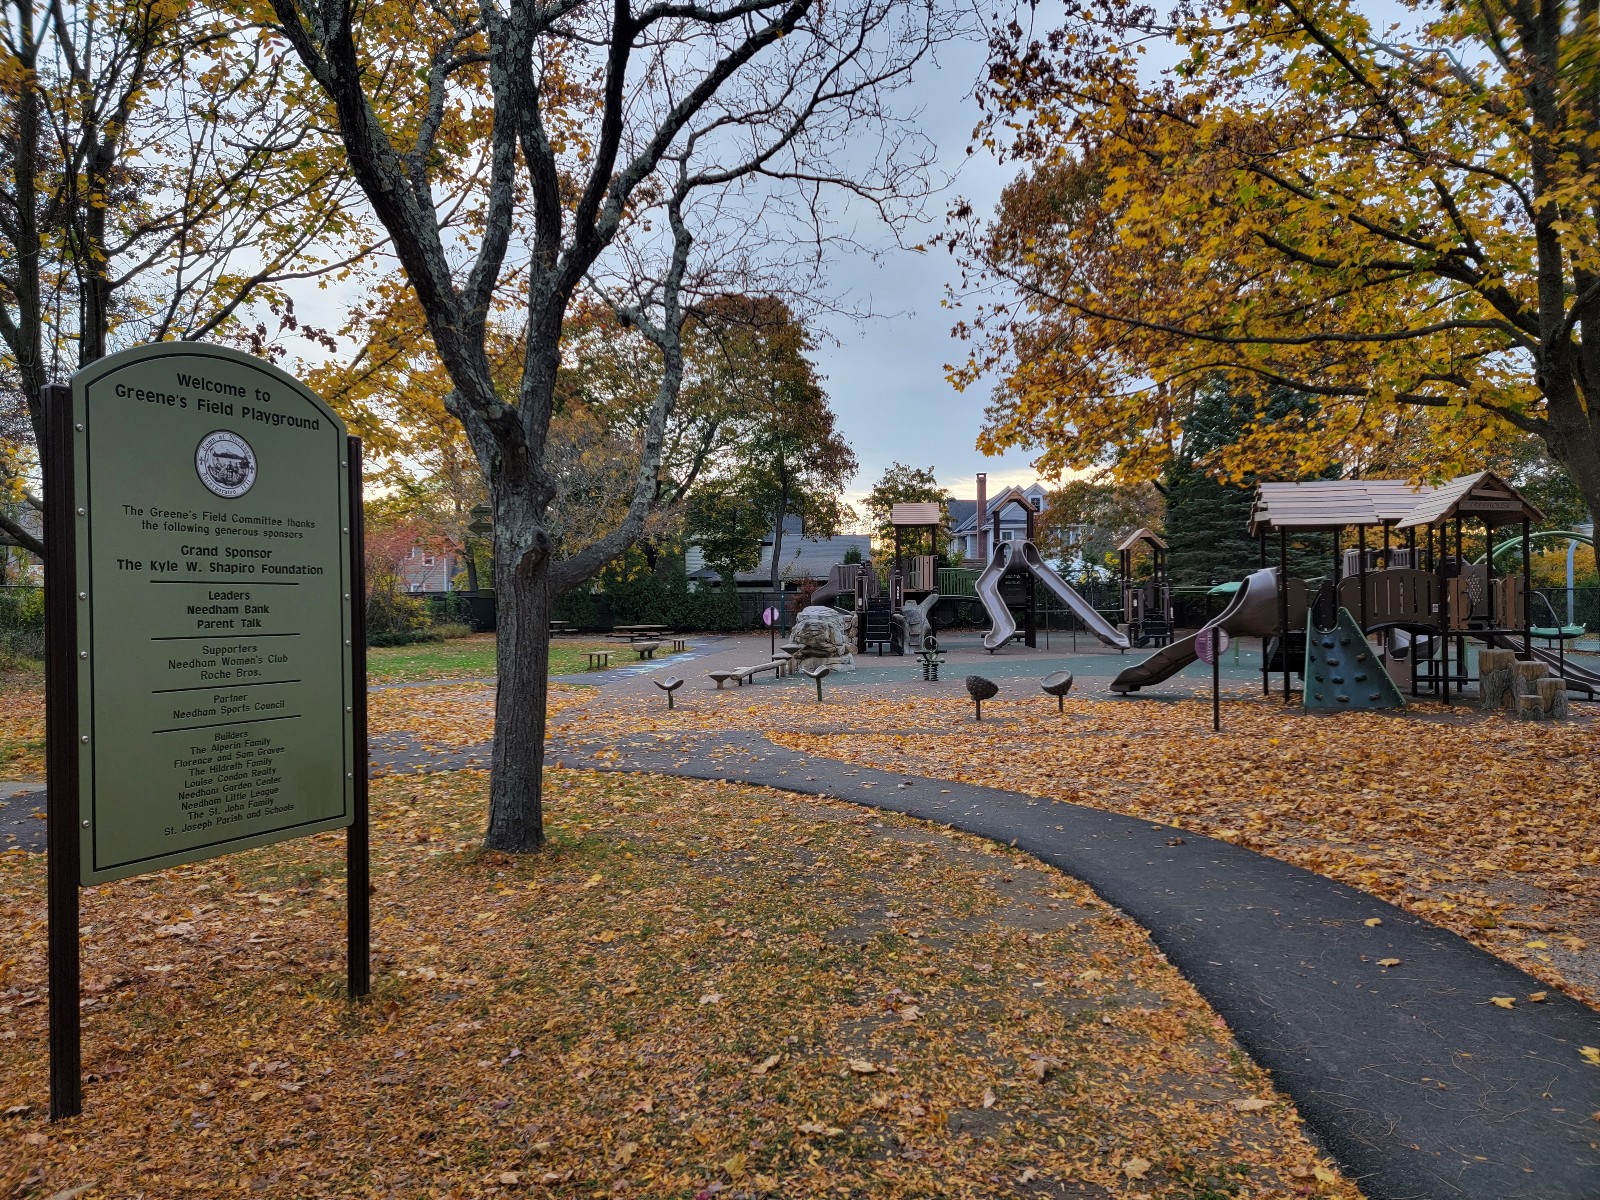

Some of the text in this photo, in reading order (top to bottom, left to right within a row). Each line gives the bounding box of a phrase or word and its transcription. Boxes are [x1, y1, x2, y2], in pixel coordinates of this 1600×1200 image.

[177, 372, 271, 403] Welcome to
[115, 383, 319, 430] Greene's Field Playground
[122, 504, 315, 529] The Greene's Field Committee thanks
[142, 519, 303, 540] the following generous sponsors
[181, 545, 272, 559] Grand Sponsor
[117, 559, 323, 575] The Kyle W. Shapiro Foundation
[208, 591, 250, 601] Leaders
[187, 604, 270, 615] Needham Bank
[197, 619, 262, 629] Parent Talk
[202, 644, 258, 656] Supporters
[168, 653, 288, 670] Needham Women's Club
[200, 667, 262, 680] Roche Bros.
[173, 699, 285, 719] Needham Sports Council
[213, 694, 249, 704] Partner
[190, 737, 271, 756] The Alperin Family
[214, 731, 249, 742] Builders
[174, 745, 285, 769] Florence and Sam Graves
[189, 757, 273, 777] The Hildreth Family
[178, 776, 282, 800] Needham Garden Center
[184, 767, 277, 789] Louise Condon Realty
[181, 786, 279, 810] Needham Little League
[188, 797, 275, 821] The St. John Family
[164, 803, 295, 836] St. Joseph Parish and Schools
